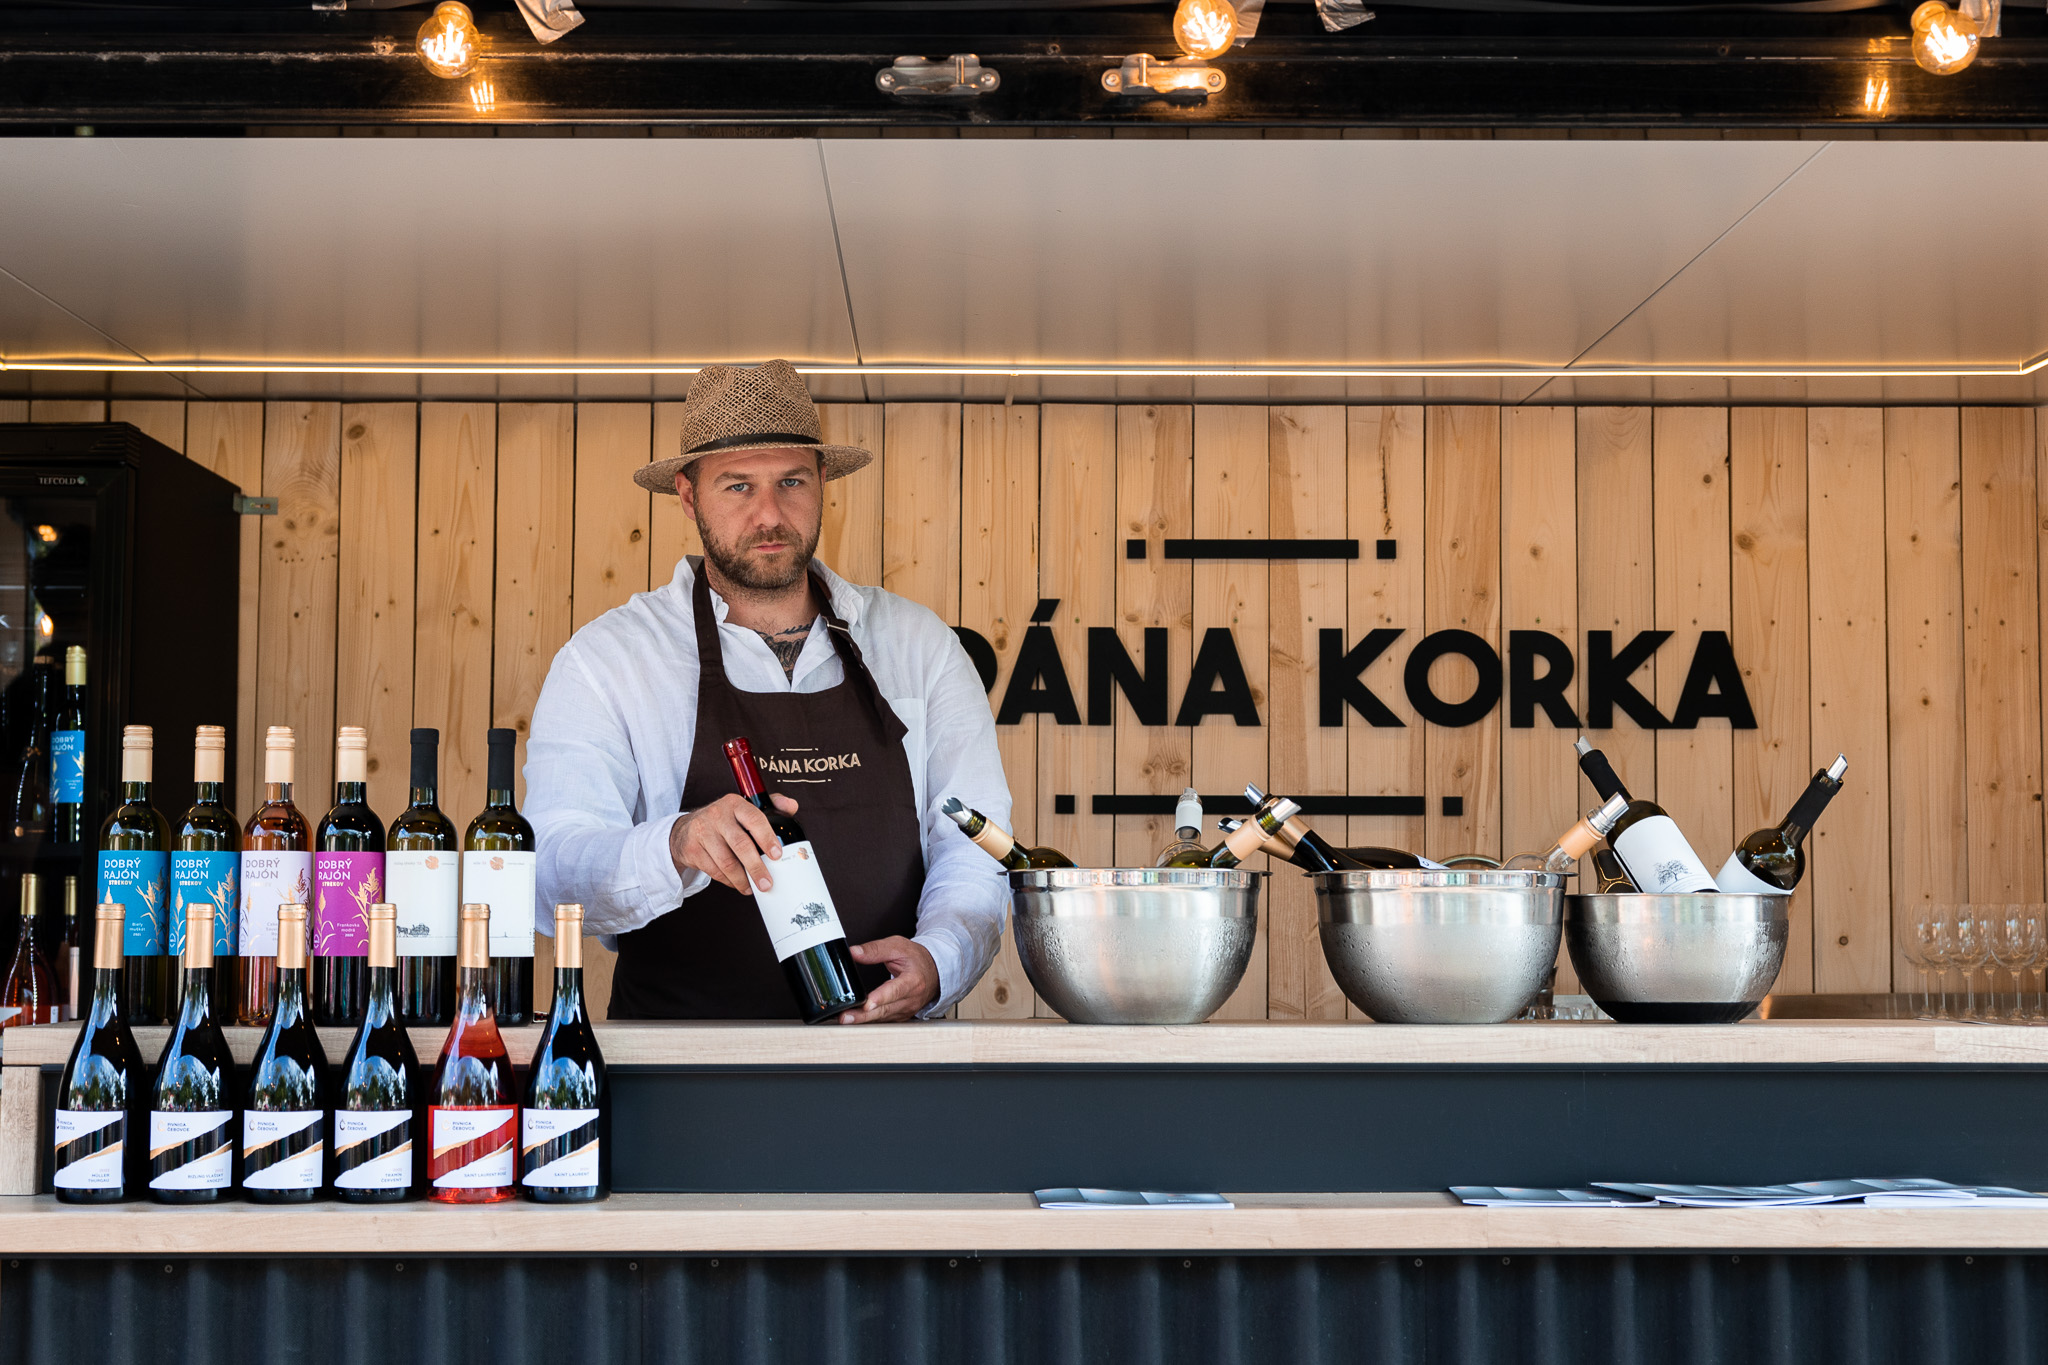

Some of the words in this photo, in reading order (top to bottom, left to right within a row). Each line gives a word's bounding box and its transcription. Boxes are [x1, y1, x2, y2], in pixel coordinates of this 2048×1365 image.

[1318, 628, 1759, 730] KORKA
[759, 755, 802, 774] PÁNA
[803, 752, 861, 773] KORKA
[104, 857, 142, 869] DOBRÝ
[175, 857, 211, 869] DOBRÝ
[245, 857, 281, 868] DOBRÝ
[318, 858, 353, 870] DOBRÝ
[104, 868, 139, 880] RAJÓN
[174, 868, 209, 880] RAJÓN
[245, 868, 279, 879] RAJÓN
[318, 869, 351, 880] RAJÓN
